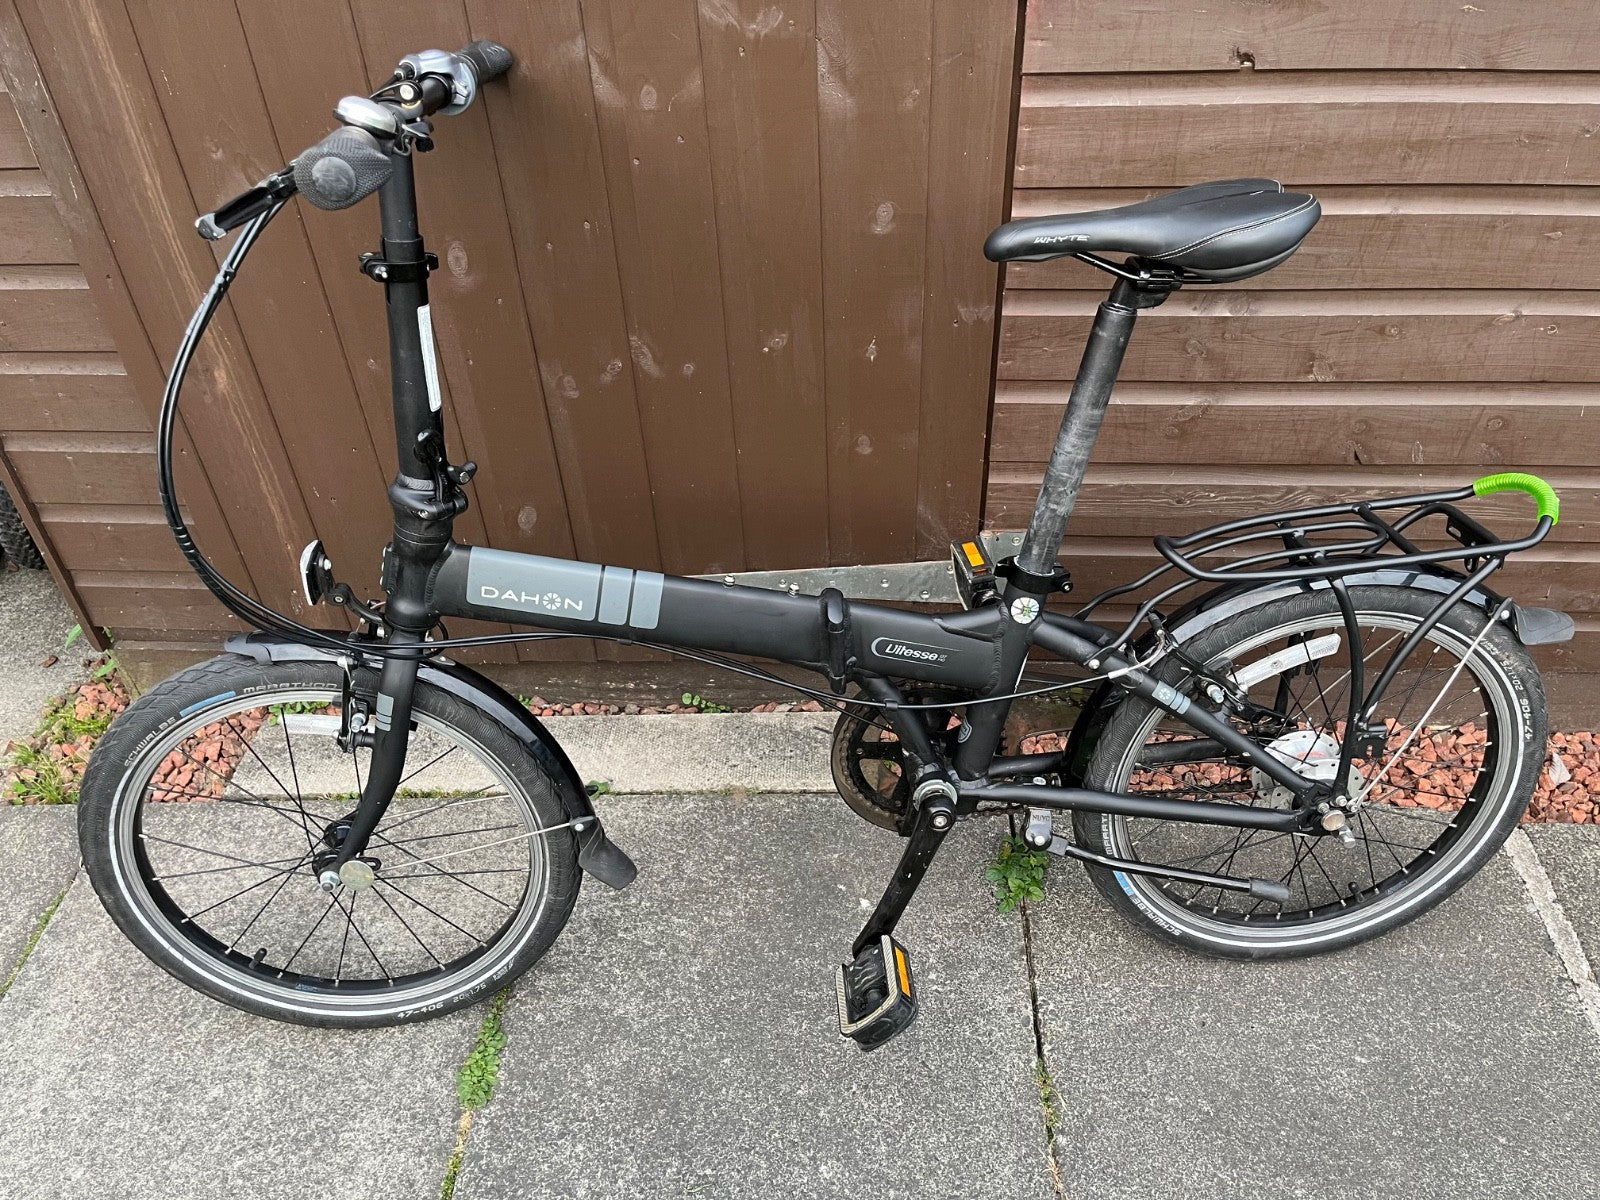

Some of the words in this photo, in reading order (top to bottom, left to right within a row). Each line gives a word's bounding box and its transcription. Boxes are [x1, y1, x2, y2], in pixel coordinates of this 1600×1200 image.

[1033, 234, 1090, 245] WHYTE
[480, 585, 583, 611] DAHON
[124, 716, 176, 767] SCHWALBE
[1131, 897, 1183, 936] SCHWALBE
[397, 1001, 444, 1019] 47-406
